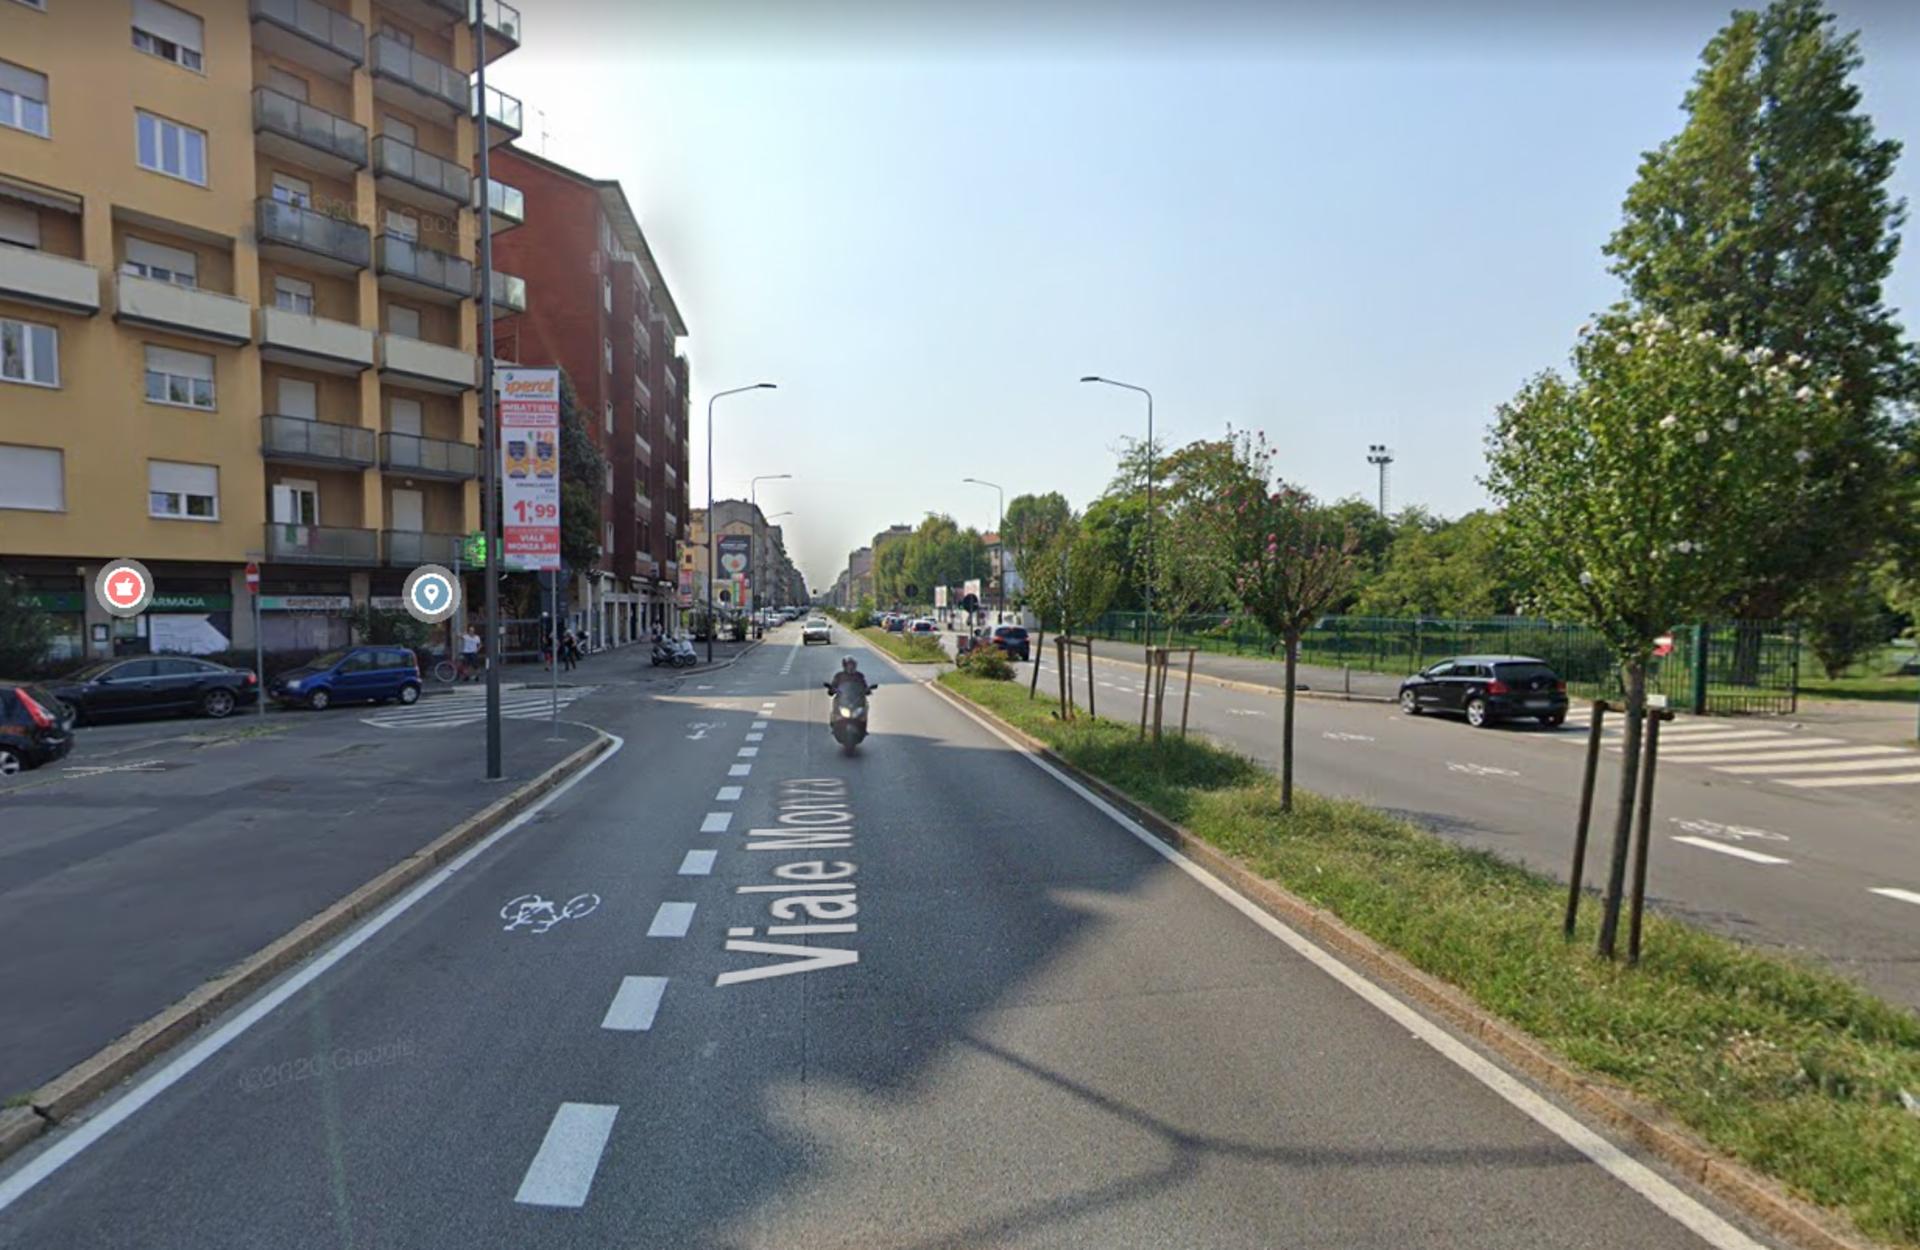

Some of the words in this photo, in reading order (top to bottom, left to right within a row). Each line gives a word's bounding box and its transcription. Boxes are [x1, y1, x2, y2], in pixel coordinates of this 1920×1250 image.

[519, 534, 545, 543] VIALE
[745, 778, 855, 850] Monza
[715, 861, 859, 988] Viale
